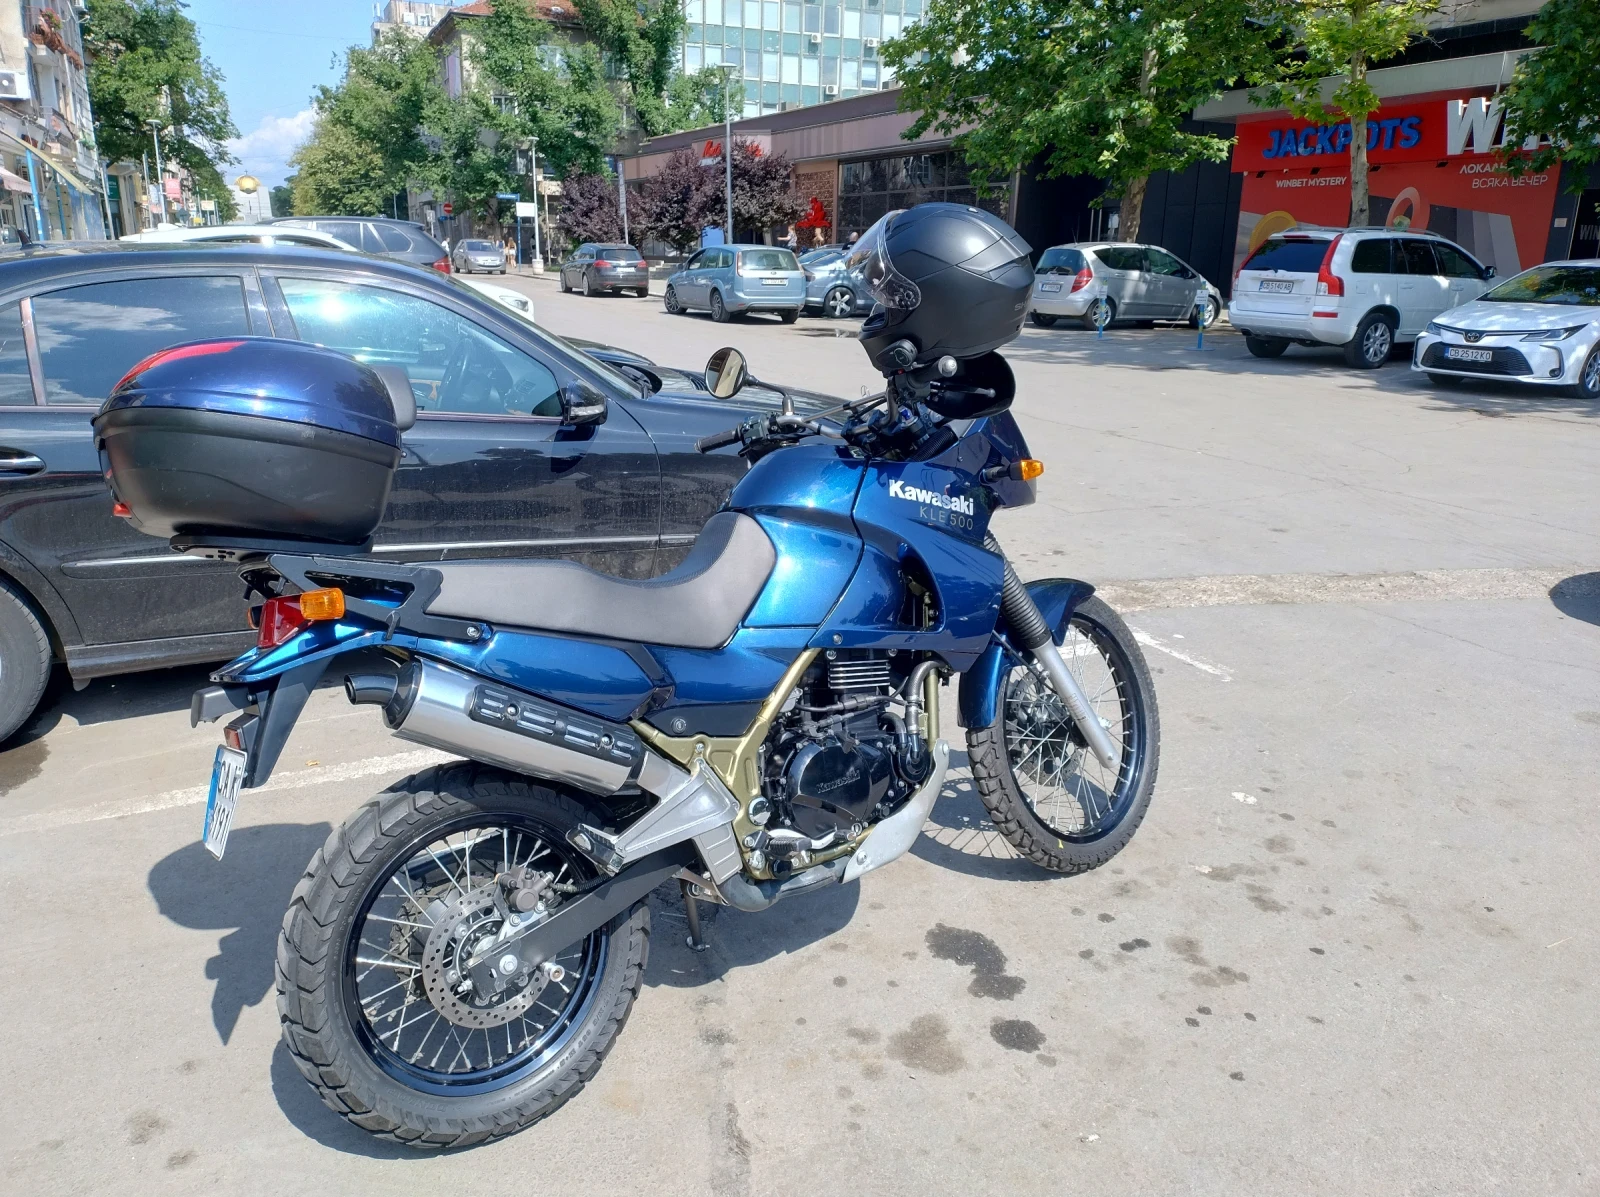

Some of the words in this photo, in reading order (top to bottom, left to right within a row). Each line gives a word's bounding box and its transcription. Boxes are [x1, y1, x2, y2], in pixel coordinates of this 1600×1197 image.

[1262, 116, 1423, 159] JACKPOTS
[1276, 178, 1308, 188] WINBET
[1308, 176, 1347, 187] MYSTERY
[1472, 178, 1509, 189] ВСЯКА
[888, 479, 974, 516] Kawasaki
[920, 505, 947, 523] KLE
[950, 513, 974, 530] 500
